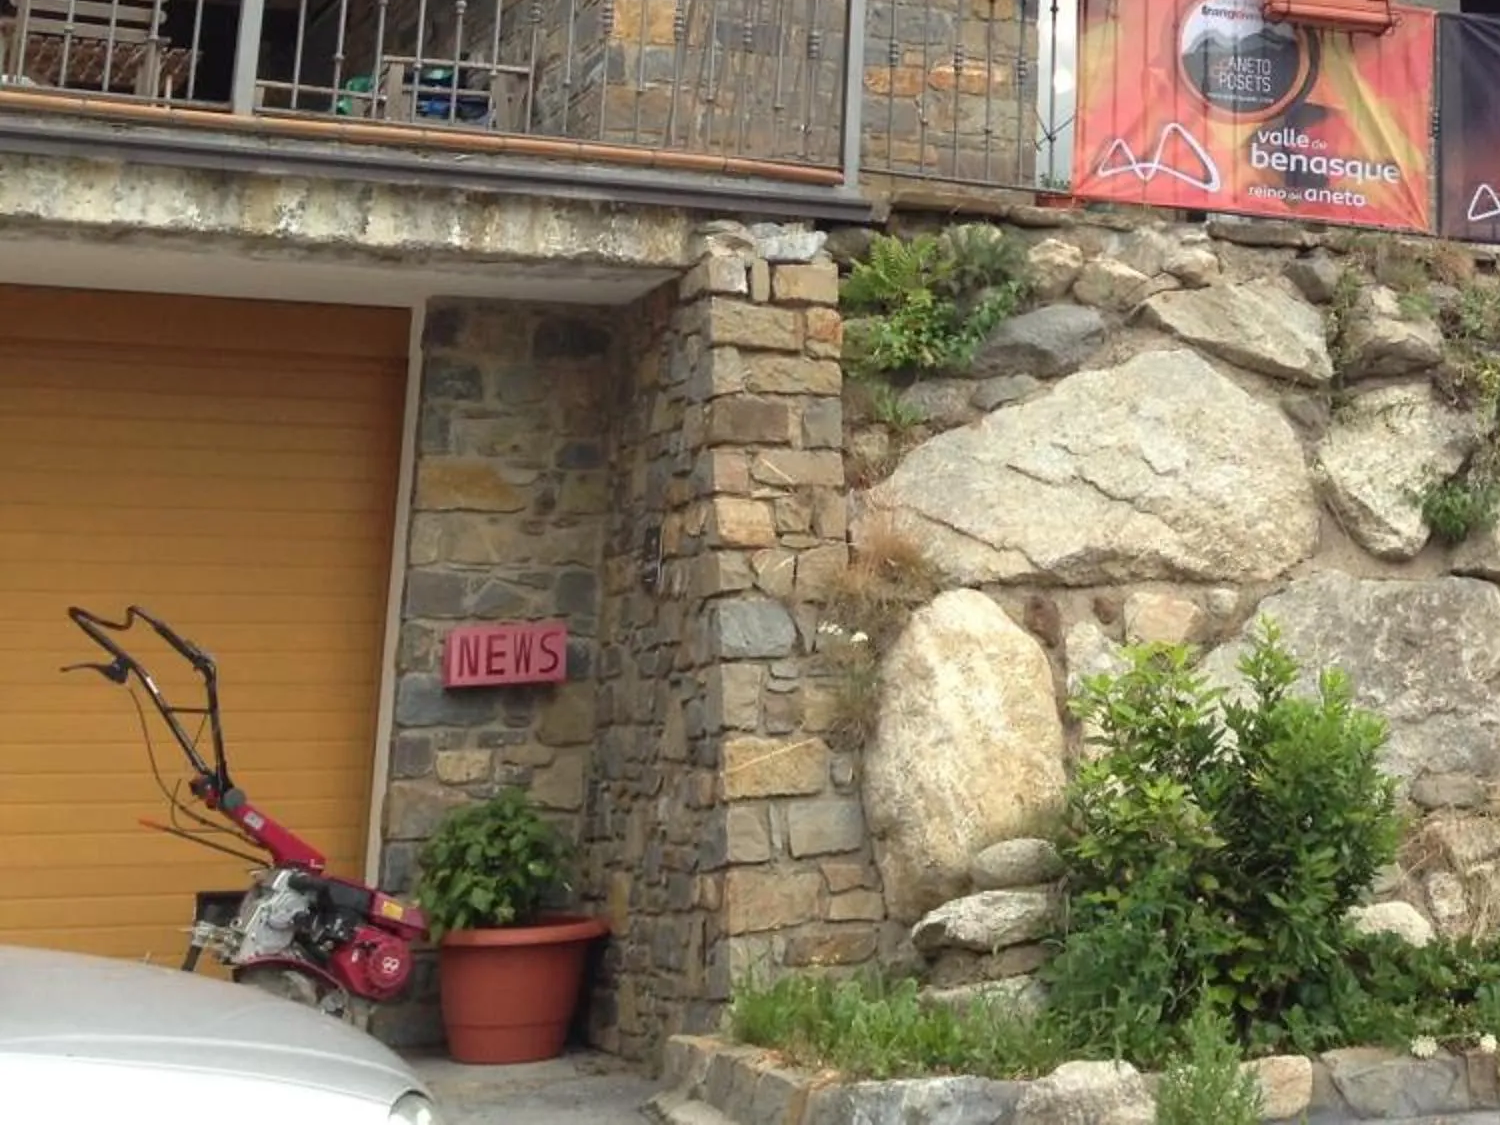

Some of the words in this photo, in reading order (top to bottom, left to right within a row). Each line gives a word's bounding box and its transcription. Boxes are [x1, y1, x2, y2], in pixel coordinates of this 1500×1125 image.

[1228, 56, 1272, 75] ANETO
[1219, 72, 1272, 92] POSETS
[1257, 127, 1310, 148] valle
[1311, 138, 1328, 150] de
[1250, 142, 1400, 185] benasque
[1248, 185, 1287, 200] reino
[1303, 187, 1368, 208] aneto
[457, 631, 561, 677] NEWS
